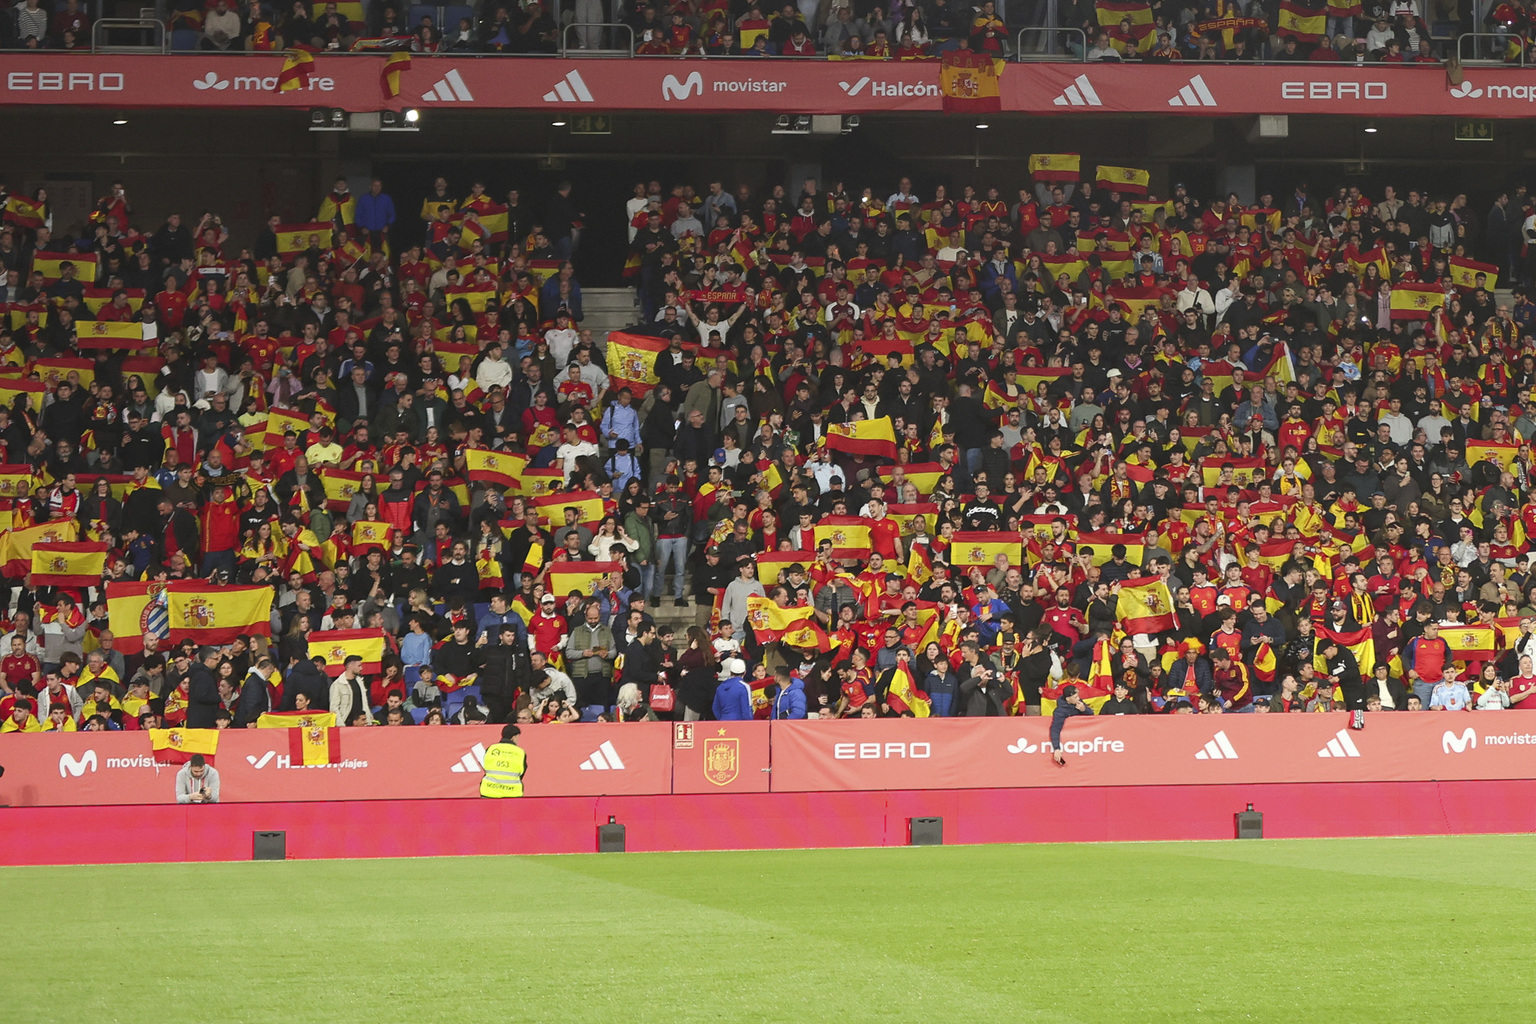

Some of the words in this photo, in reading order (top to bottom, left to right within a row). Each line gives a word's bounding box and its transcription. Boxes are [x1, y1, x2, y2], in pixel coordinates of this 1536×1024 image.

[7, 72, 124, 92] EBRO
[233, 72, 335, 95] mare
[713, 78, 787, 94] movistar
[872, 79, 938, 97] Halcón
[1281, 82, 1388, 100] EBRO
[835, 742, 931, 760] EBRO
[1040, 736, 1125, 757] mapfre
